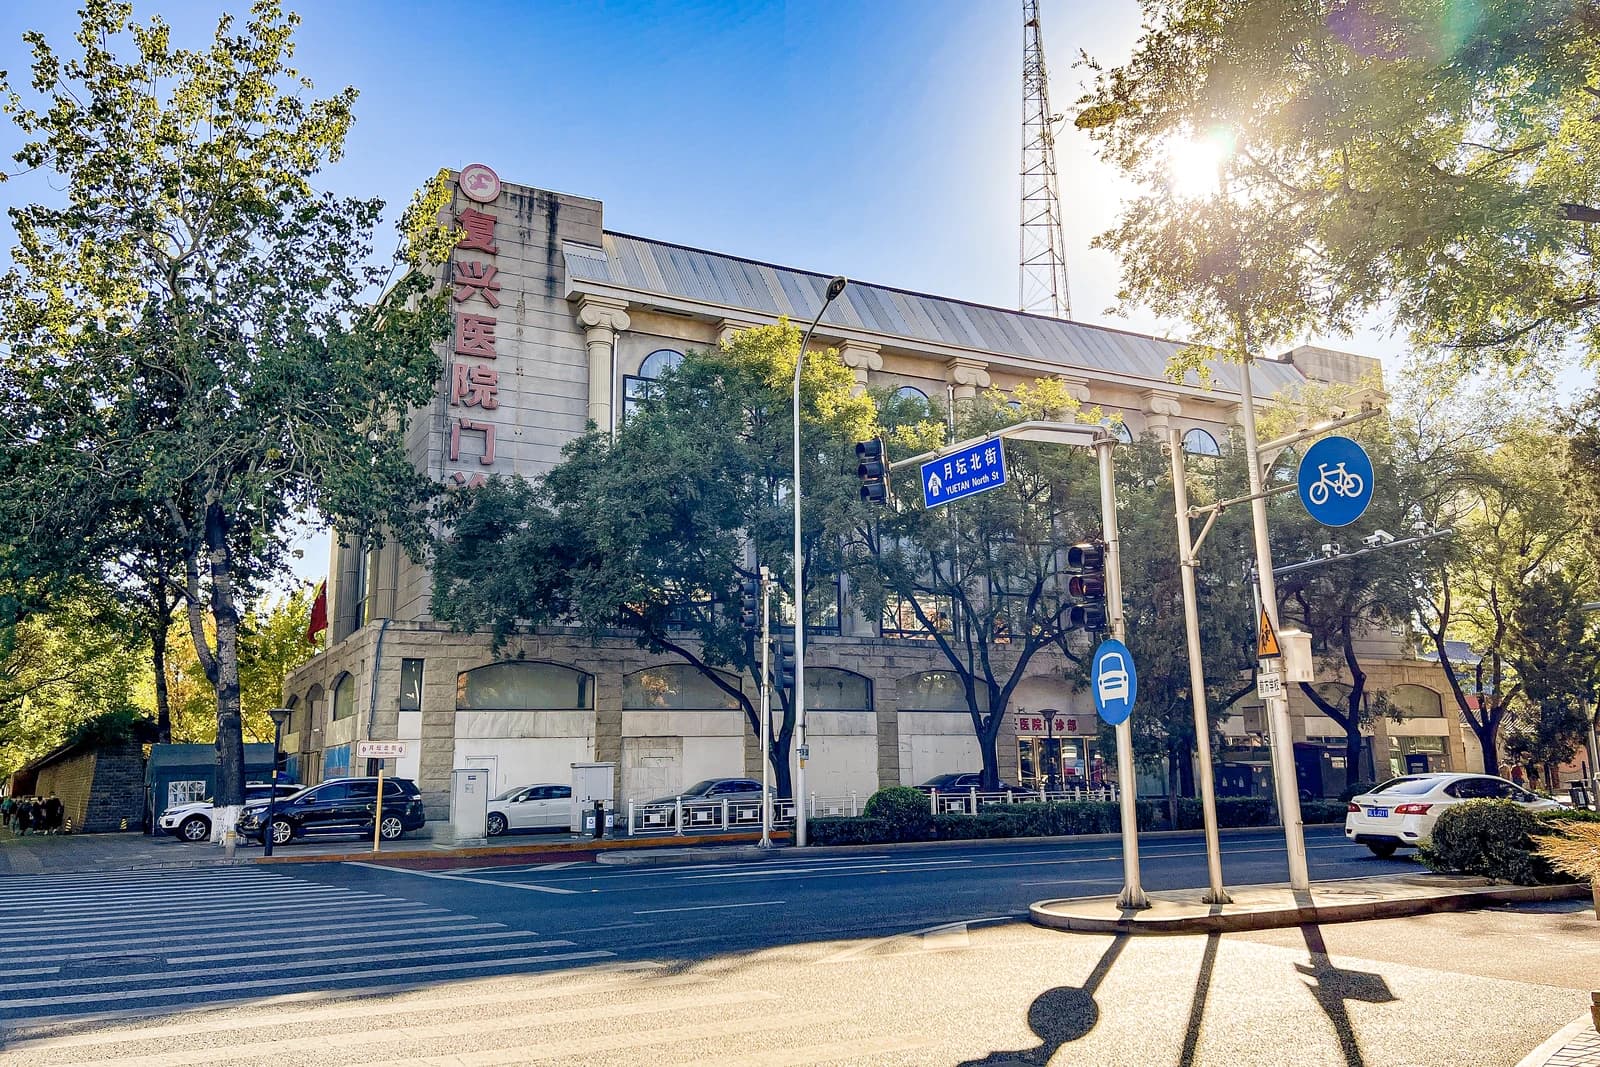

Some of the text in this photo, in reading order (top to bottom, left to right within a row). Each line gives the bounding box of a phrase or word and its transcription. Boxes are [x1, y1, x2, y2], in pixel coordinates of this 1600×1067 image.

[944, 447, 997, 480] 月坛北街
[945, 480, 970, 495] YUETAN
[972, 473, 989, 487] North
[991, 471, 999, 480] St
[1015, 717, 1077, 732] 医院诊部
